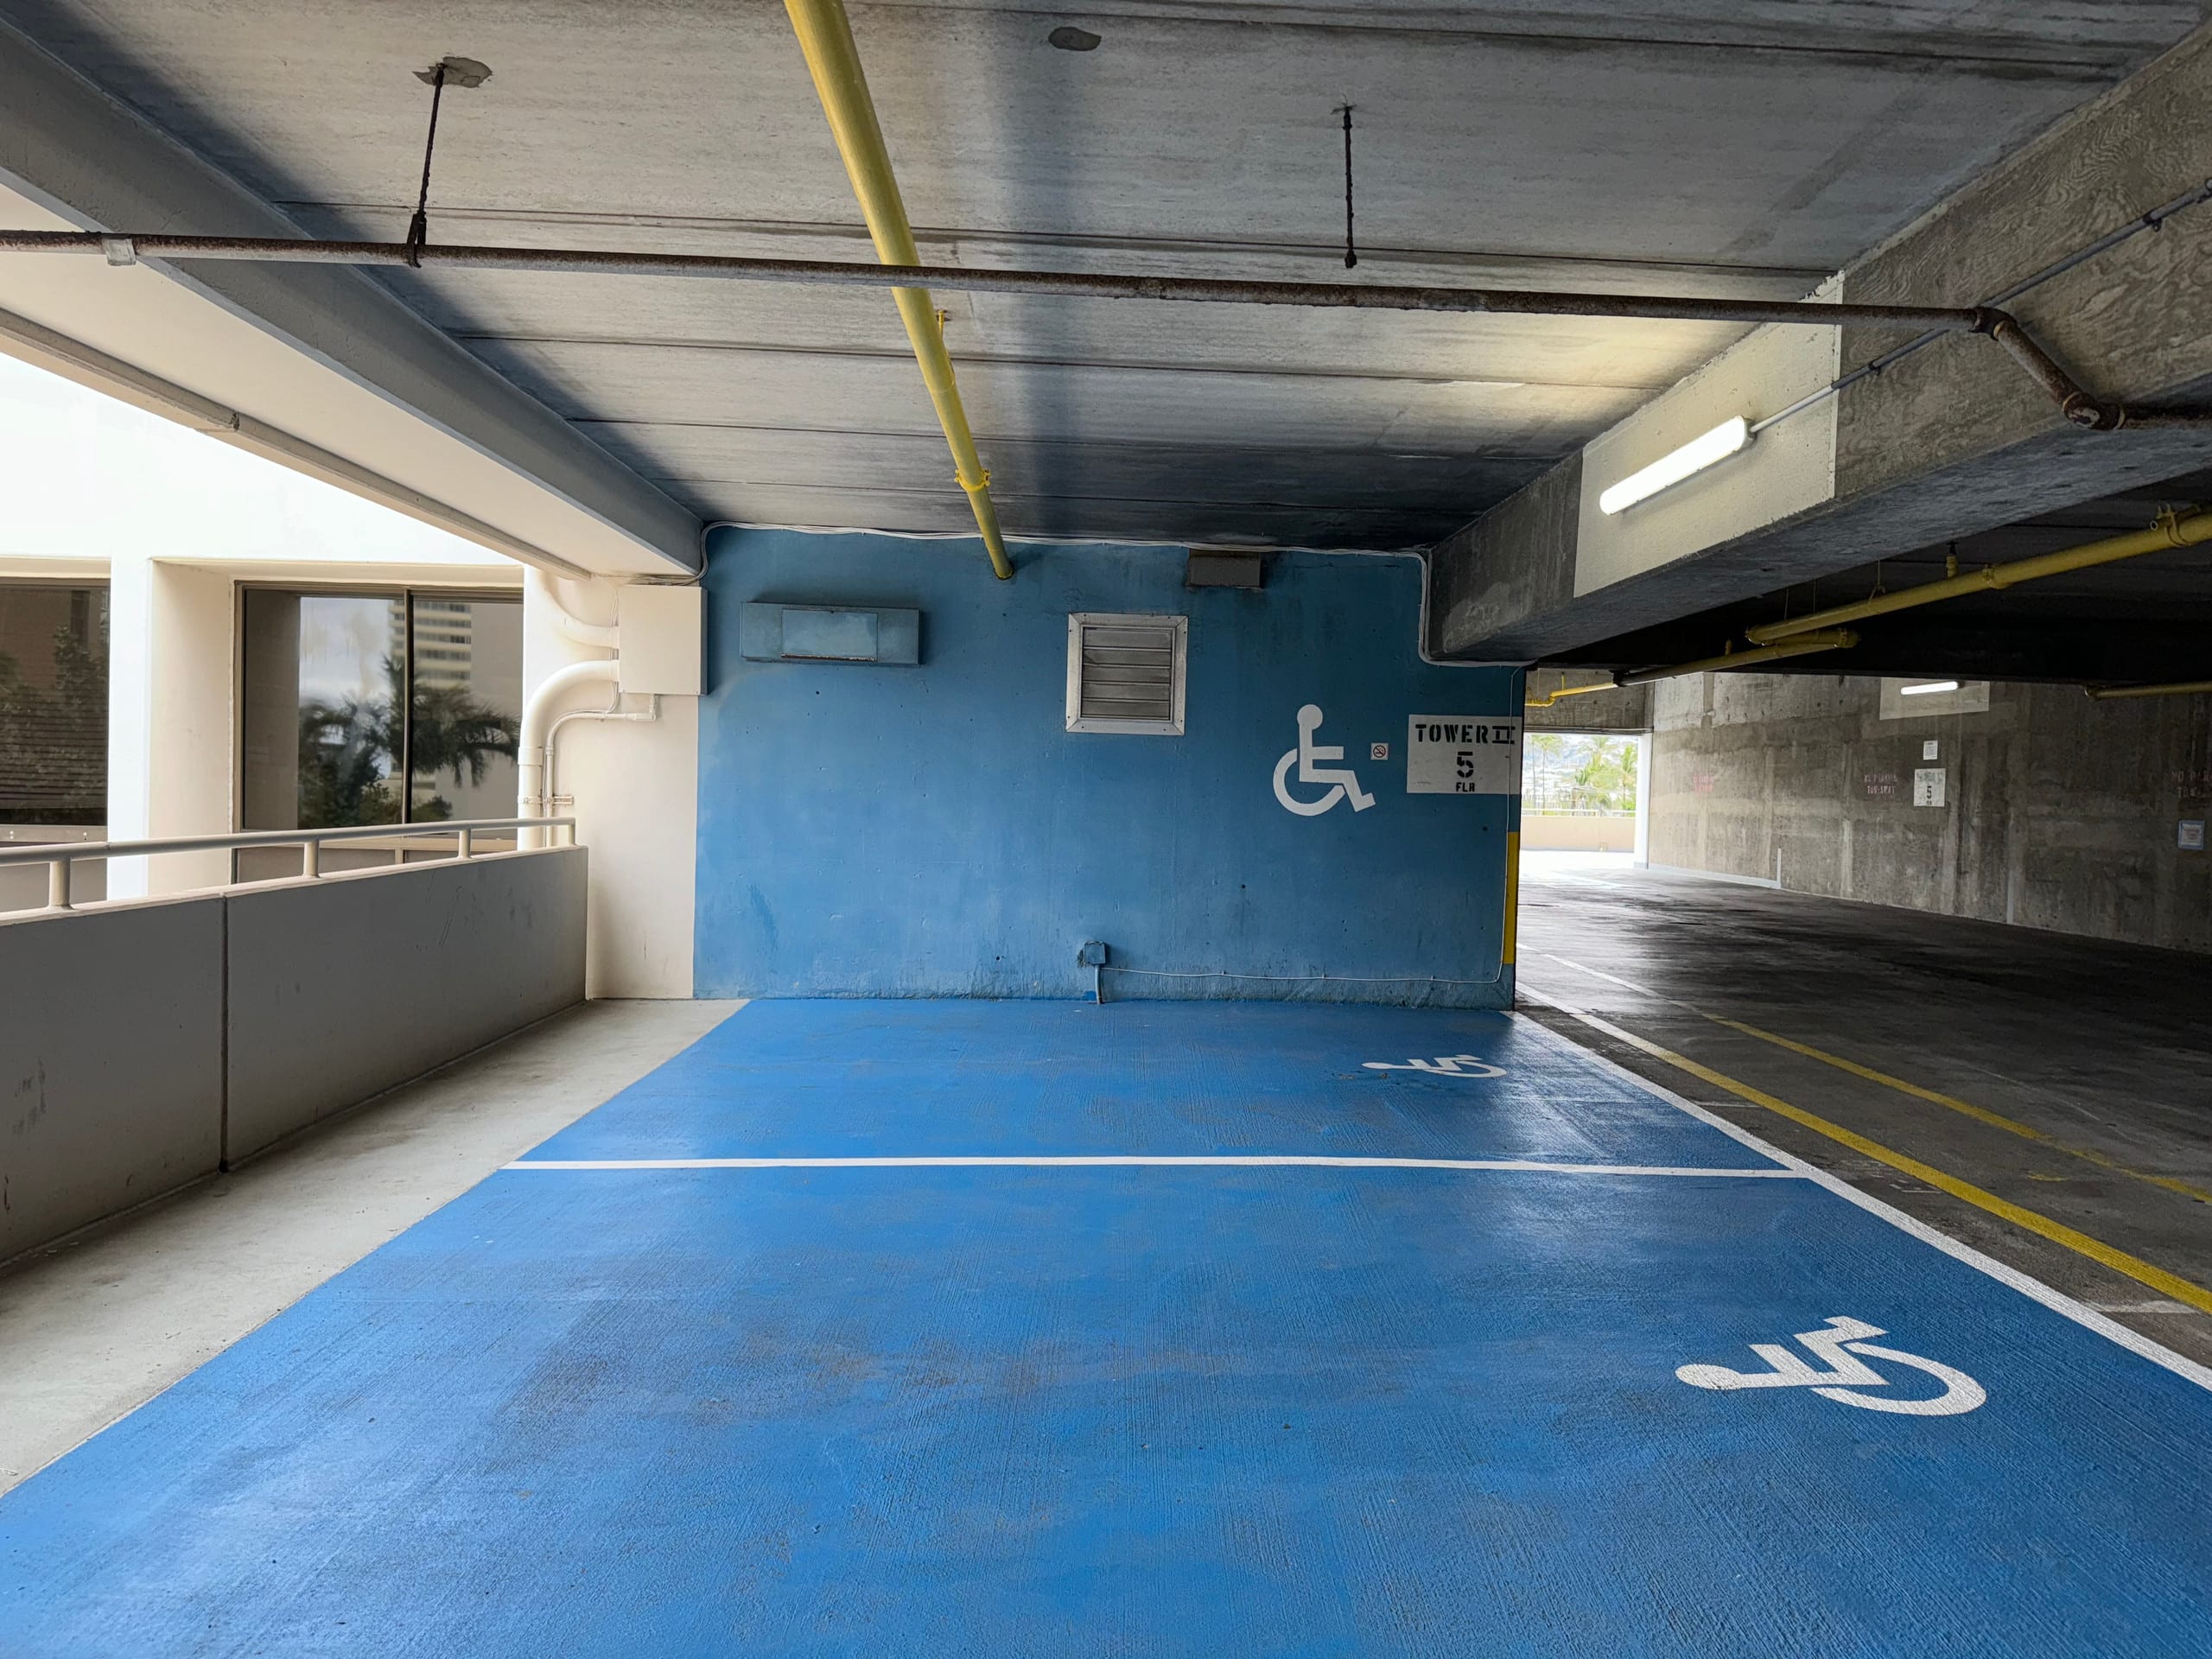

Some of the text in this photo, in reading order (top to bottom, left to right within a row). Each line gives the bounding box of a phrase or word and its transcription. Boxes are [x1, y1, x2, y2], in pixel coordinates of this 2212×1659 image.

[1415, 724, 1488, 743] TOWER
[1457, 752, 1474, 778] 5
[1455, 782, 1475, 792] FLR
